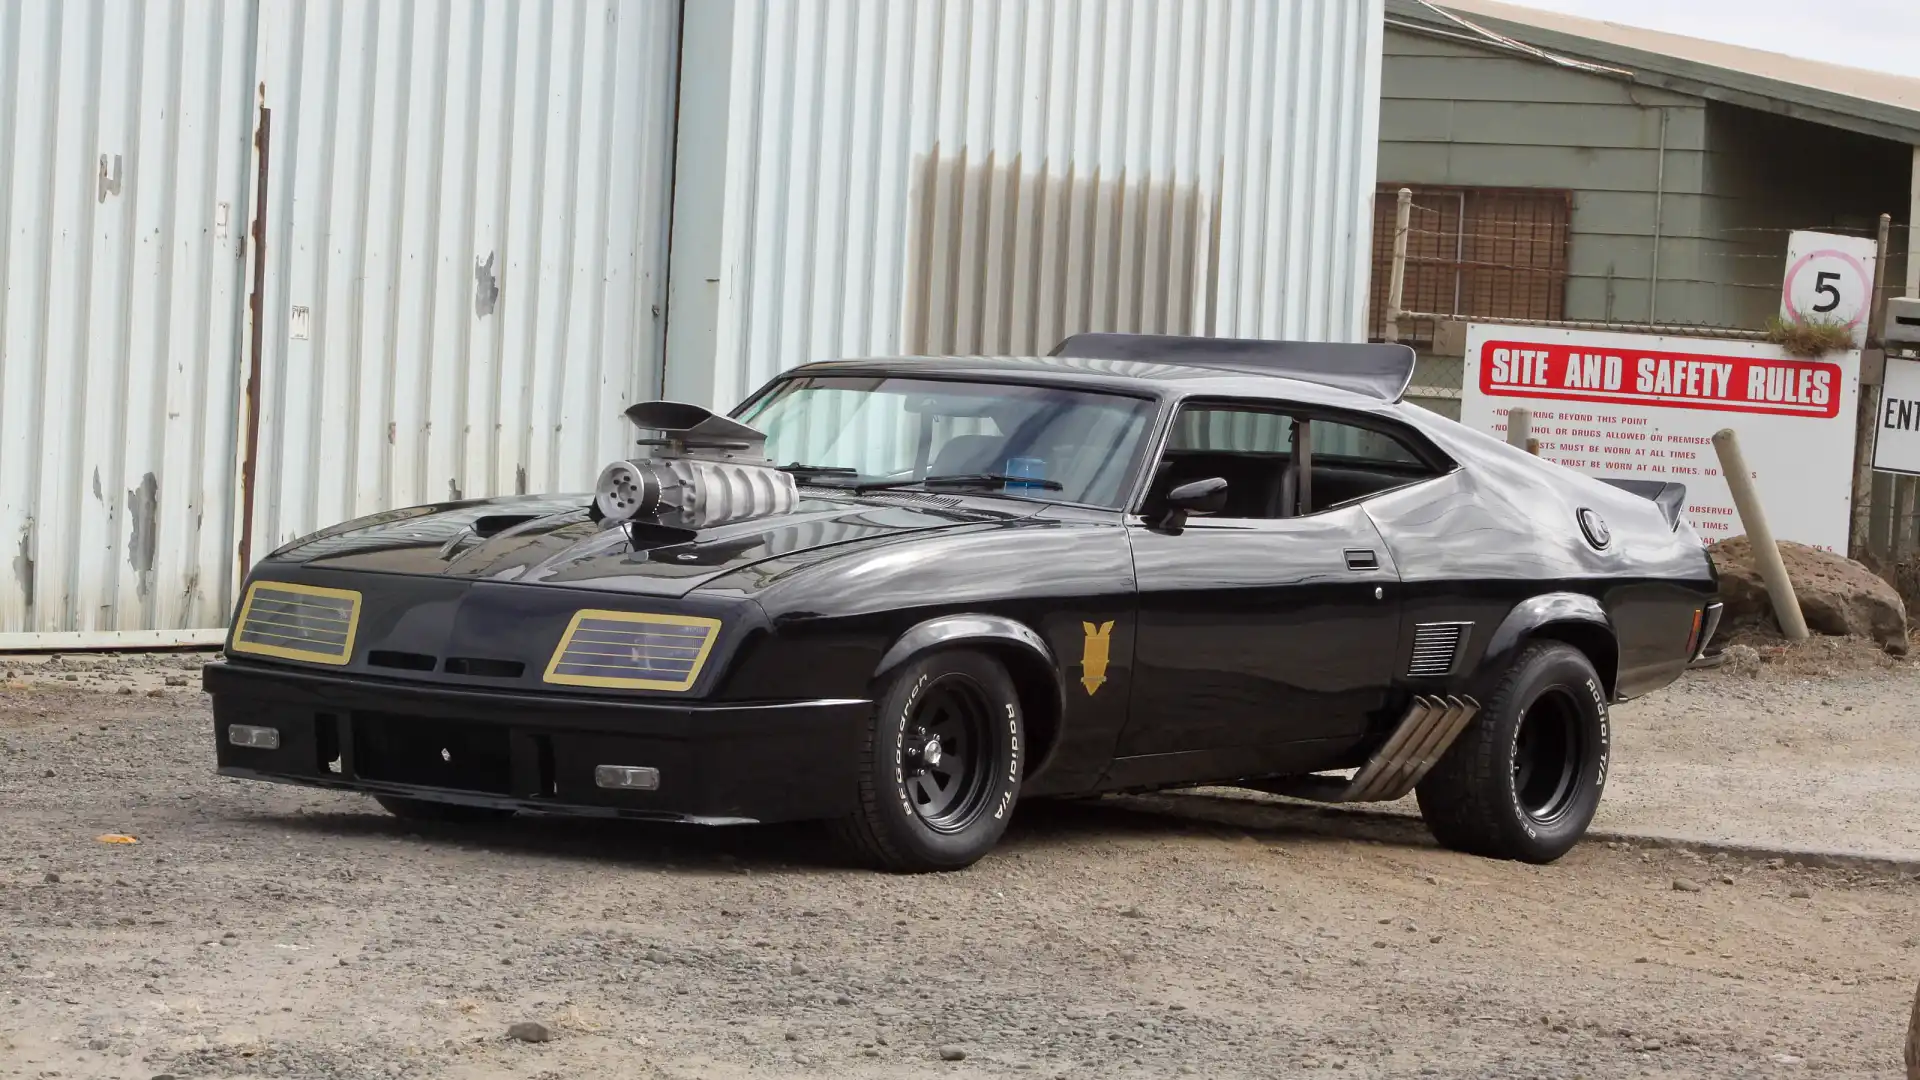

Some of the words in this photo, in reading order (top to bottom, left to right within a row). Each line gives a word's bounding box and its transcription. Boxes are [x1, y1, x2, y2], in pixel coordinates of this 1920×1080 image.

[1812, 271, 1841, 313] 5
[1491, 348, 1549, 386] SITE
[1563, 353, 1623, 391] AND
[1636, 357, 1733, 398] SAFETY
[1747, 365, 1831, 405] RULES
[1558, 412, 1593, 422] BEYOND
[1597, 415, 1617, 424] THIS
[1621, 417, 1648, 426] POINT
[1495, 424, 1508, 432] NO
[1555, 427, 1568, 436] OR
[1571, 429, 1602, 438] DRUGS
[1605, 431, 1646, 441] ALLOWED
[1650, 434, 1663, 443] ON
[1667, 435, 1711, 445] PREMISES
[1559, 443, 1585, 452] MUST
[1588, 445, 1600, 453] BE
[1604, 446, 1631, 455] WORN
[1635, 448, 1646, 456] AT
[1649, 449, 1666, 458] ALL
[1670, 450, 1696, 460] TIMES
[1561, 458, 1587, 468] MUST
[1590, 460, 1601, 469] BE
[1605, 461, 1632, 471] WORN
[1636, 463, 1648, 472] AT
[1651, 464, 1667, 473] ALL
[1704, 468, 1717, 477] NO
[1689, 505, 1734, 516] OBSERVED
[1702, 521, 1729, 531] TIMES
[1585, 678, 1606, 744] Radial
[1596, 752, 1607, 786] T/A
[1005, 703, 1019, 783] Radial
[994, 790, 1012, 820] T/A
